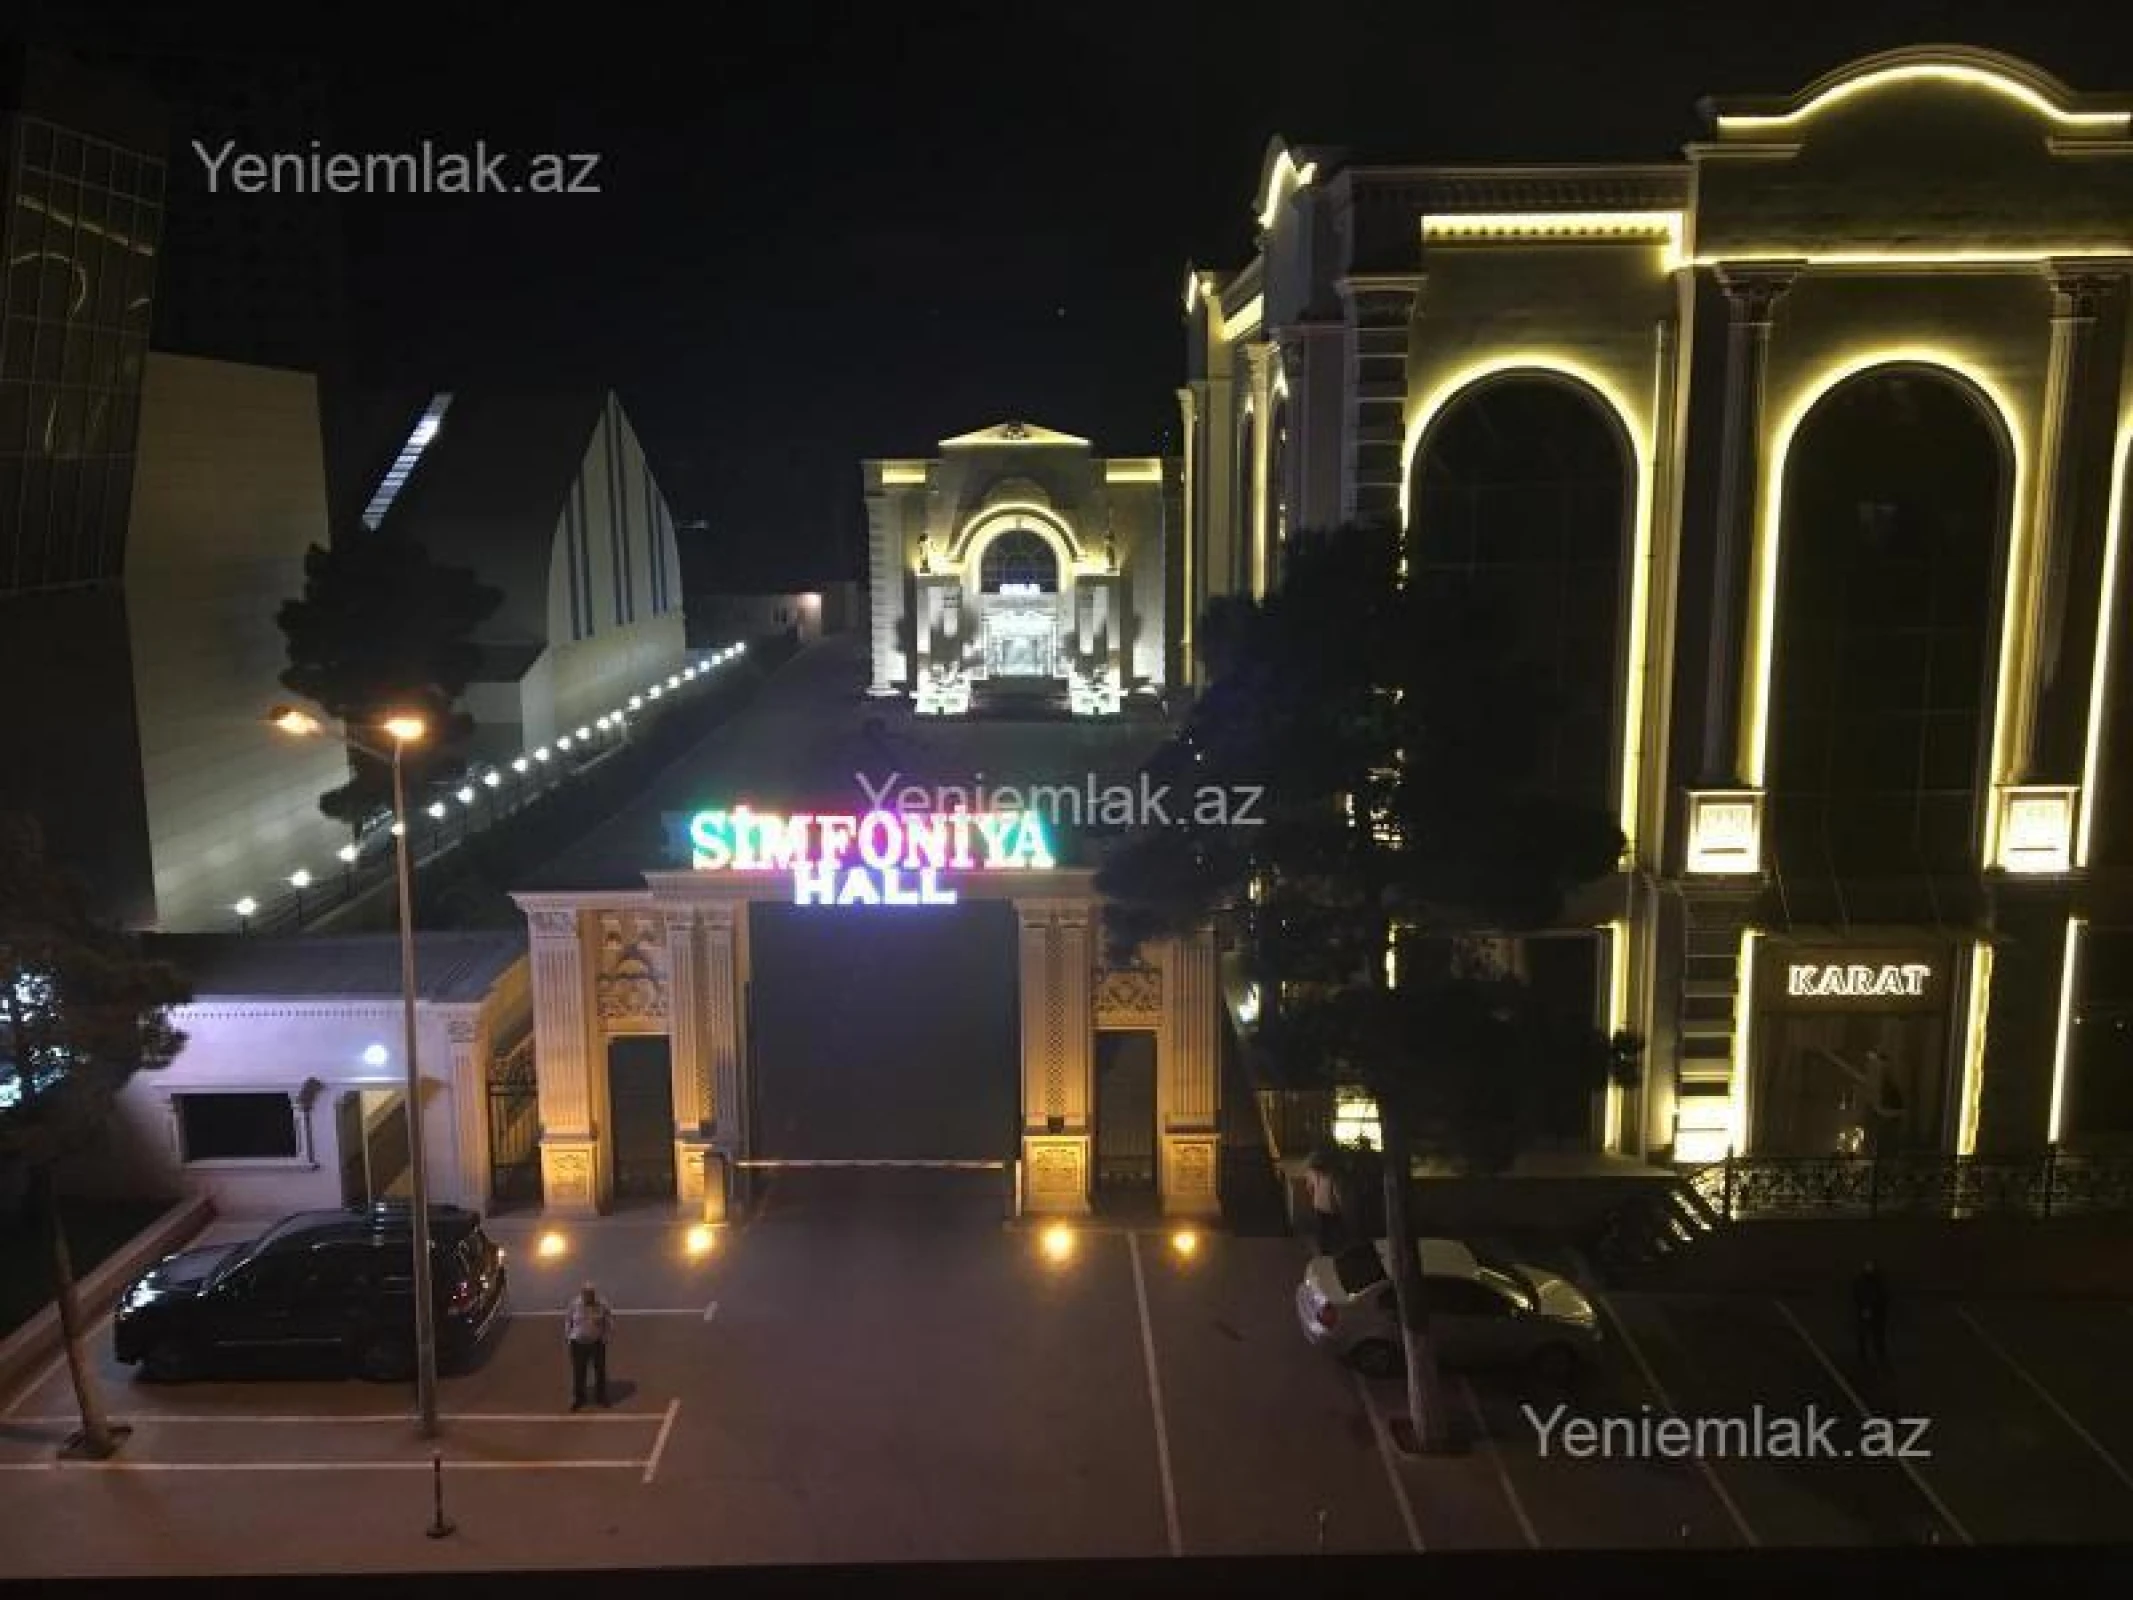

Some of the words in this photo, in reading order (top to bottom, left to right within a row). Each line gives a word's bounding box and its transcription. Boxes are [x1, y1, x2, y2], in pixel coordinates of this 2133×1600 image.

[690, 804, 1055, 870] SİMFONİYA
[794, 867, 957, 905] HALL
[1788, 964, 1931, 996] KARAT
